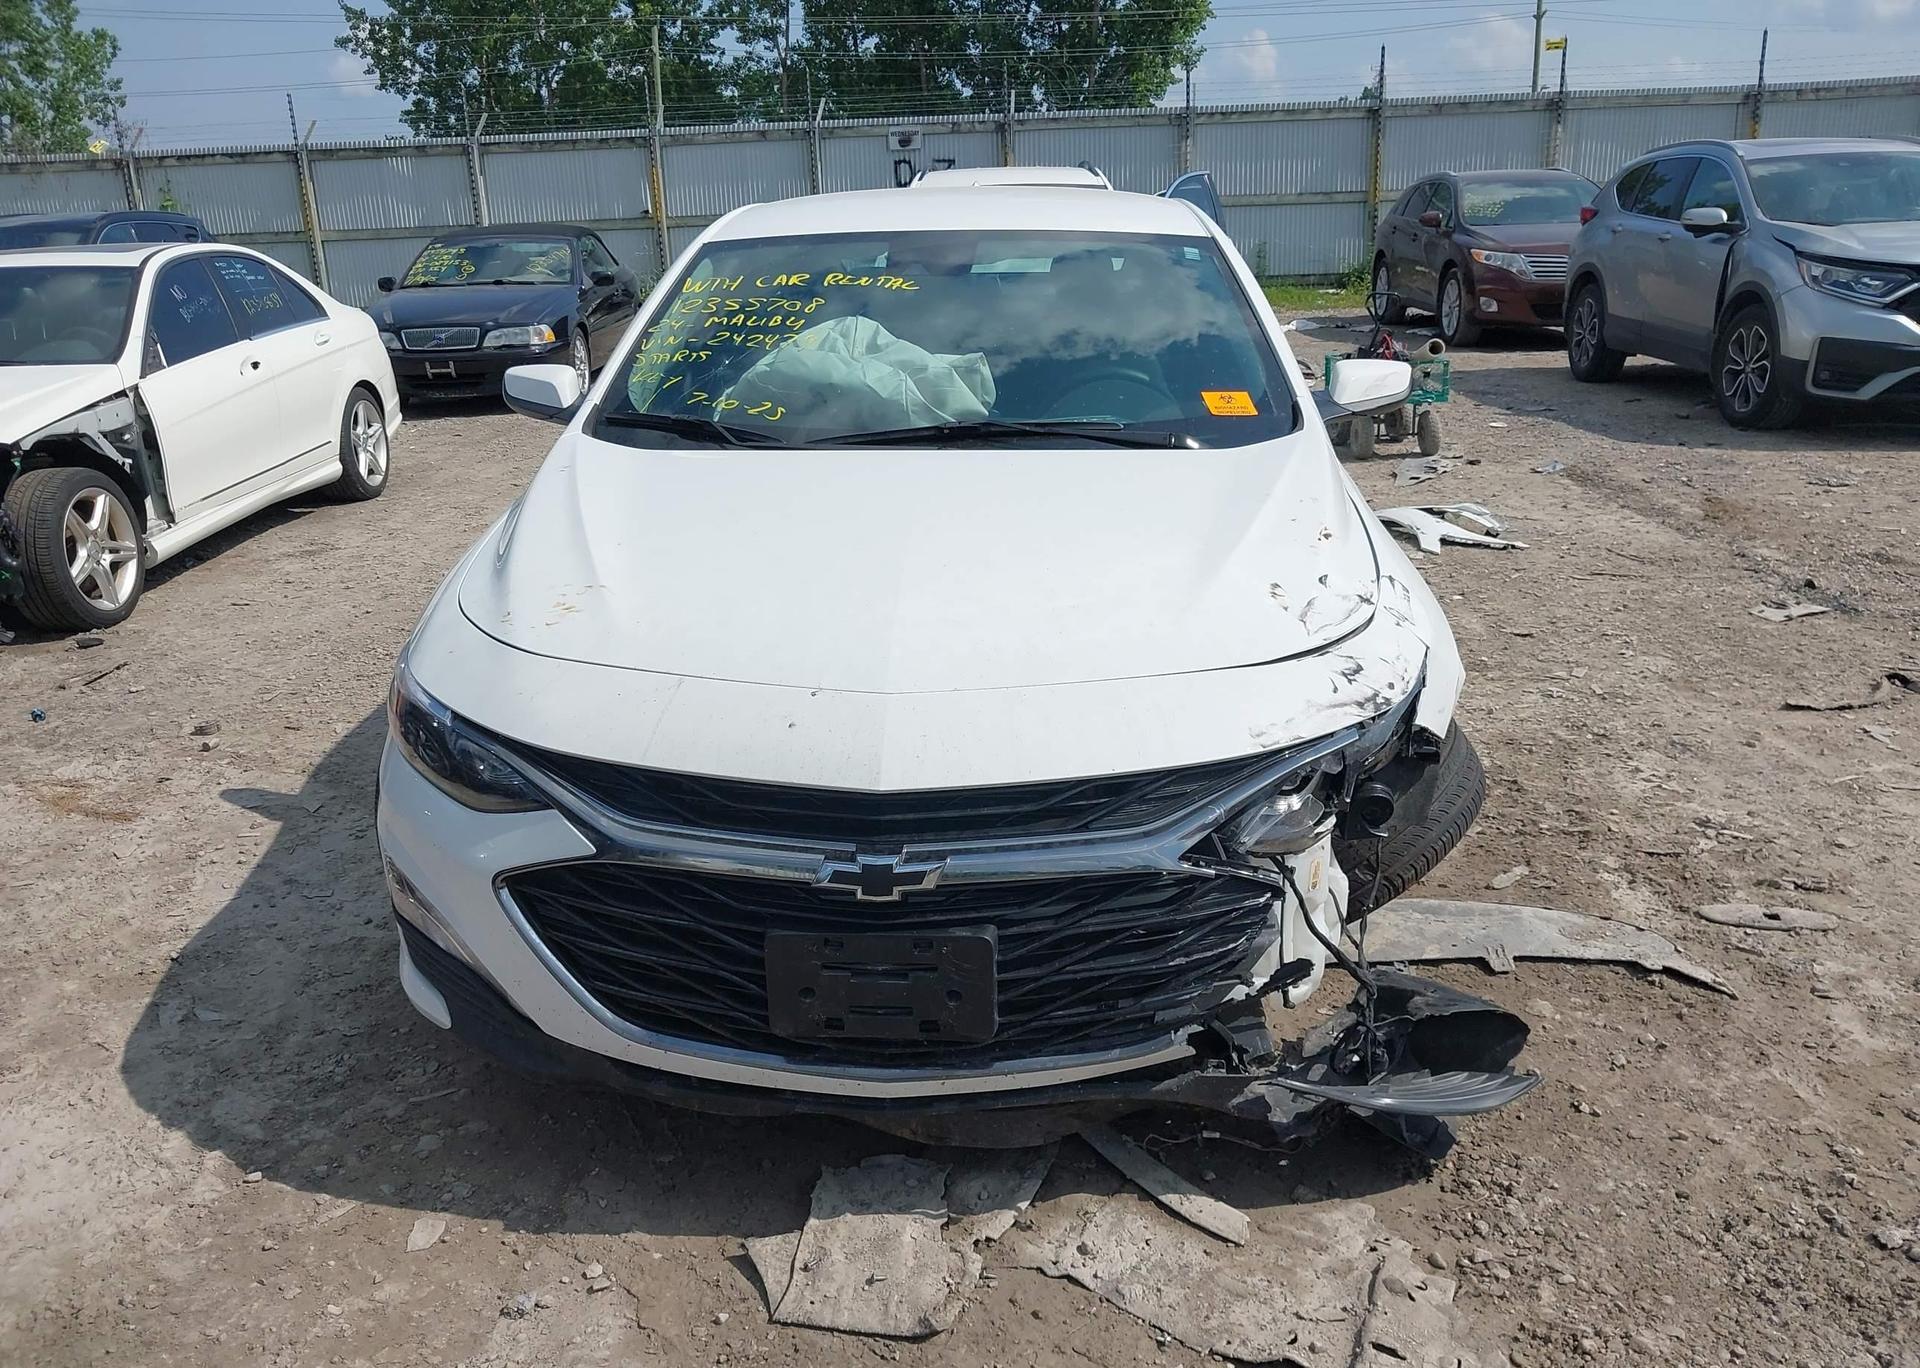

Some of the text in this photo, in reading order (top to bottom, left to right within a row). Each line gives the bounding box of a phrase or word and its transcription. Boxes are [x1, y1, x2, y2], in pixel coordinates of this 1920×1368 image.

[755, 272, 811, 289] CAR
[822, 273, 921, 291] RENTAL
[671, 297, 826, 314] 12355708
[632, 349, 712, 367] STARTS
